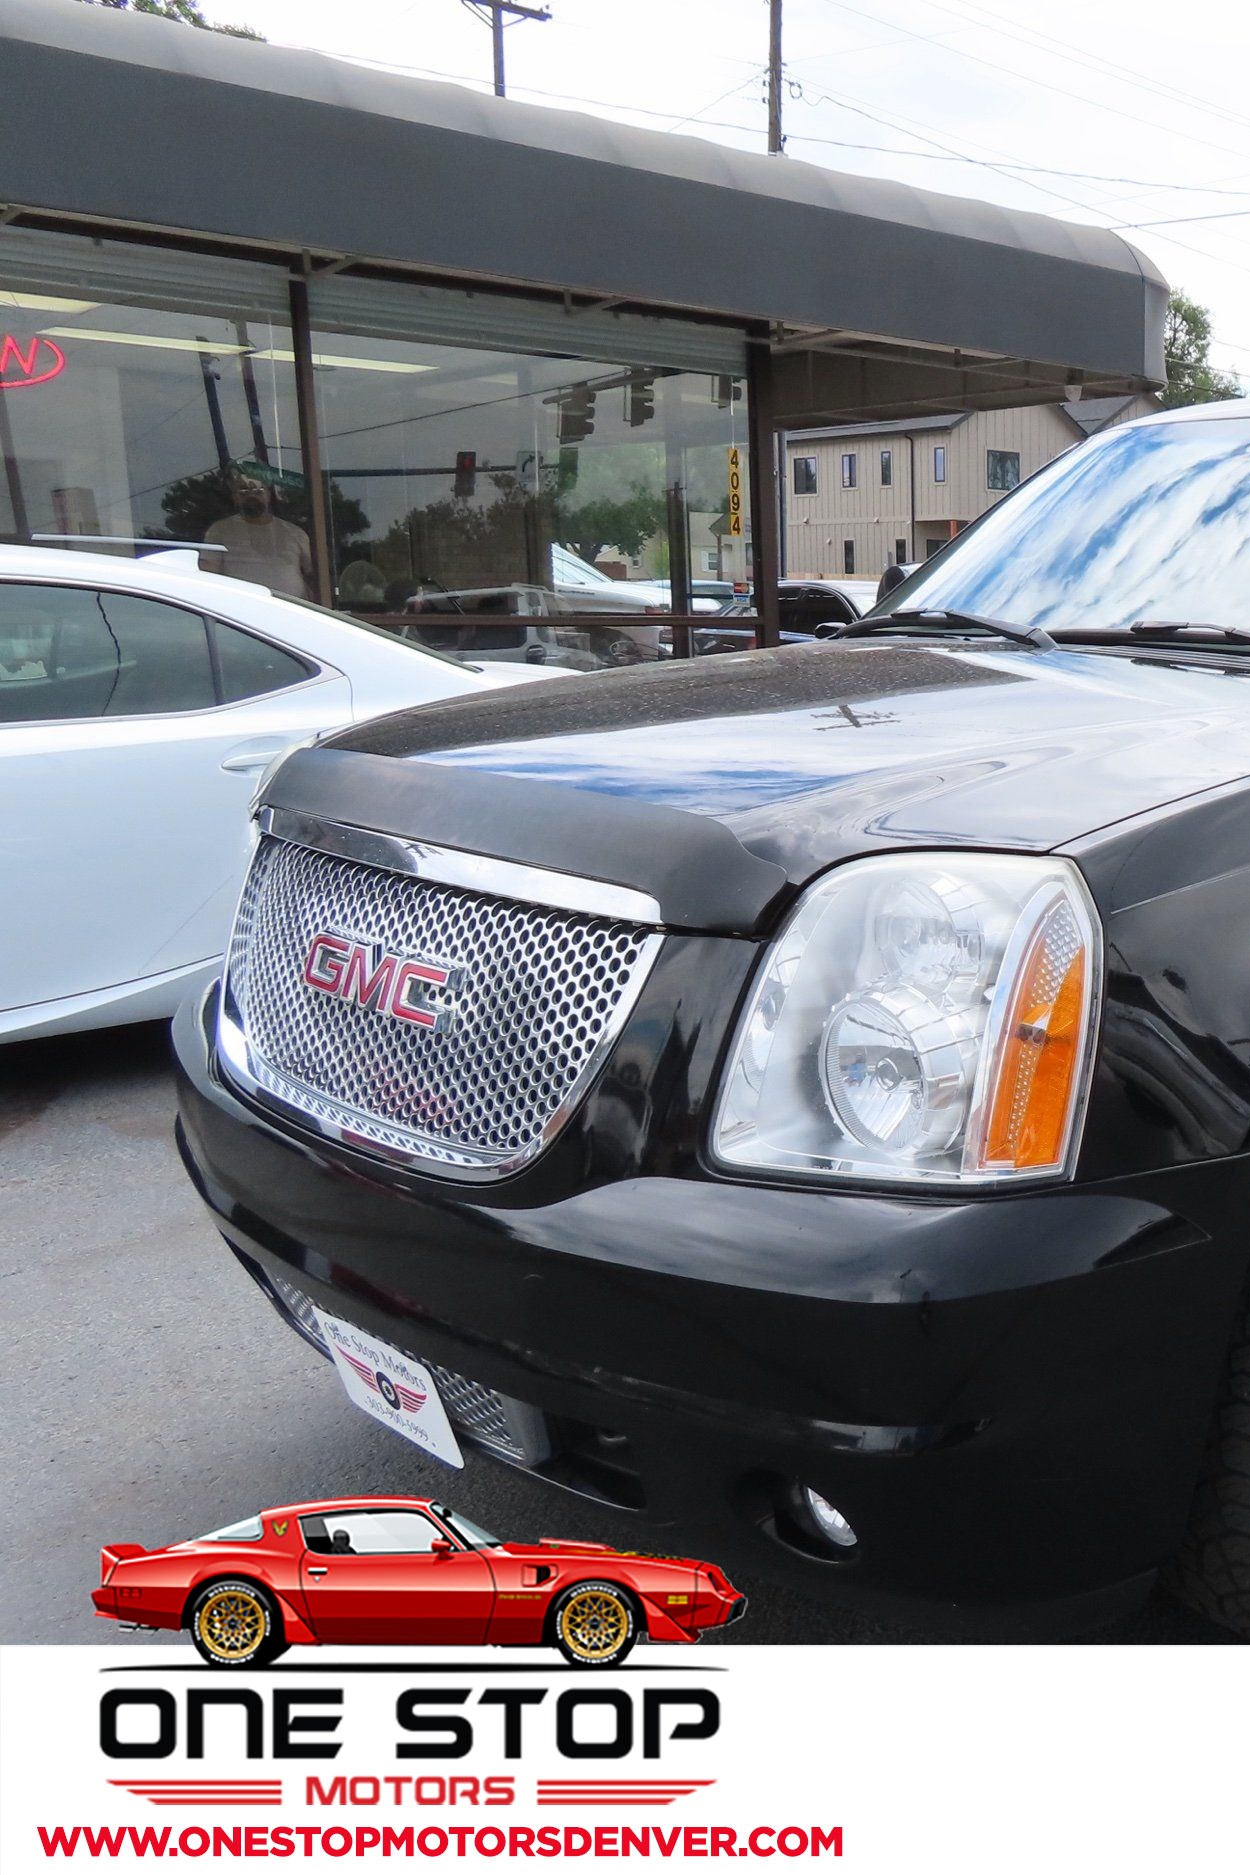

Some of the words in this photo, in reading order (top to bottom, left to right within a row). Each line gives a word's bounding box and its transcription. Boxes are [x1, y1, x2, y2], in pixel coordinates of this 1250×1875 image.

[729, 448, 742, 536] 4094
[304, 929, 462, 1033] GMC
[324, 1322, 351, 1348] One
[351, 1335, 380, 1367] Stop
[381, 1350, 427, 1392] Motors
